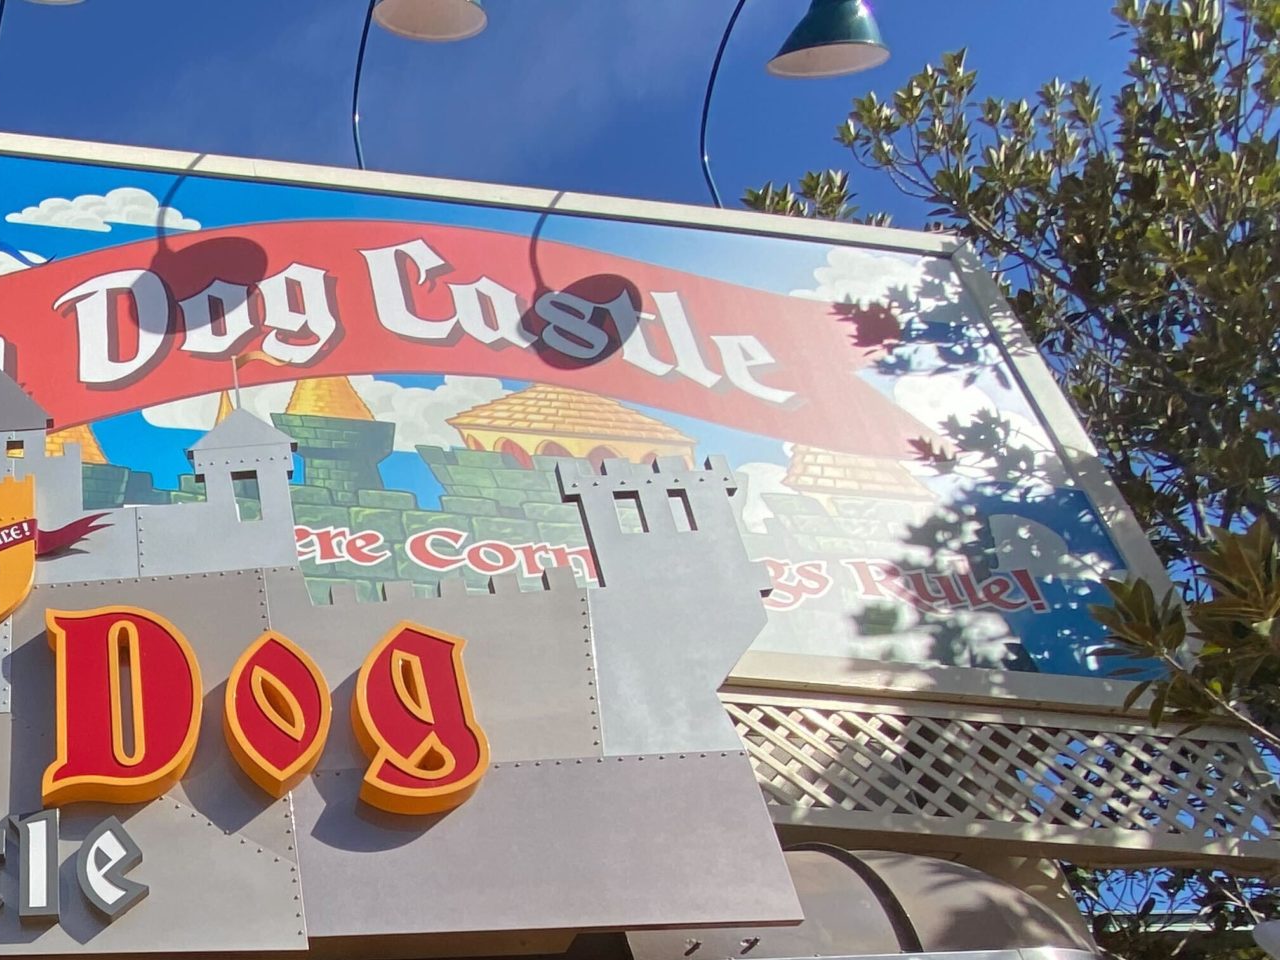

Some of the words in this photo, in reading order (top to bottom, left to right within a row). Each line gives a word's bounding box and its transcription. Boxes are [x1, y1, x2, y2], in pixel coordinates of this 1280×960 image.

[53, 261, 329, 383] Dog
[360, 238, 797, 404] Castle
[841, 557, 1051, 617] Rule!
[43, 605, 491, 815] Dog
